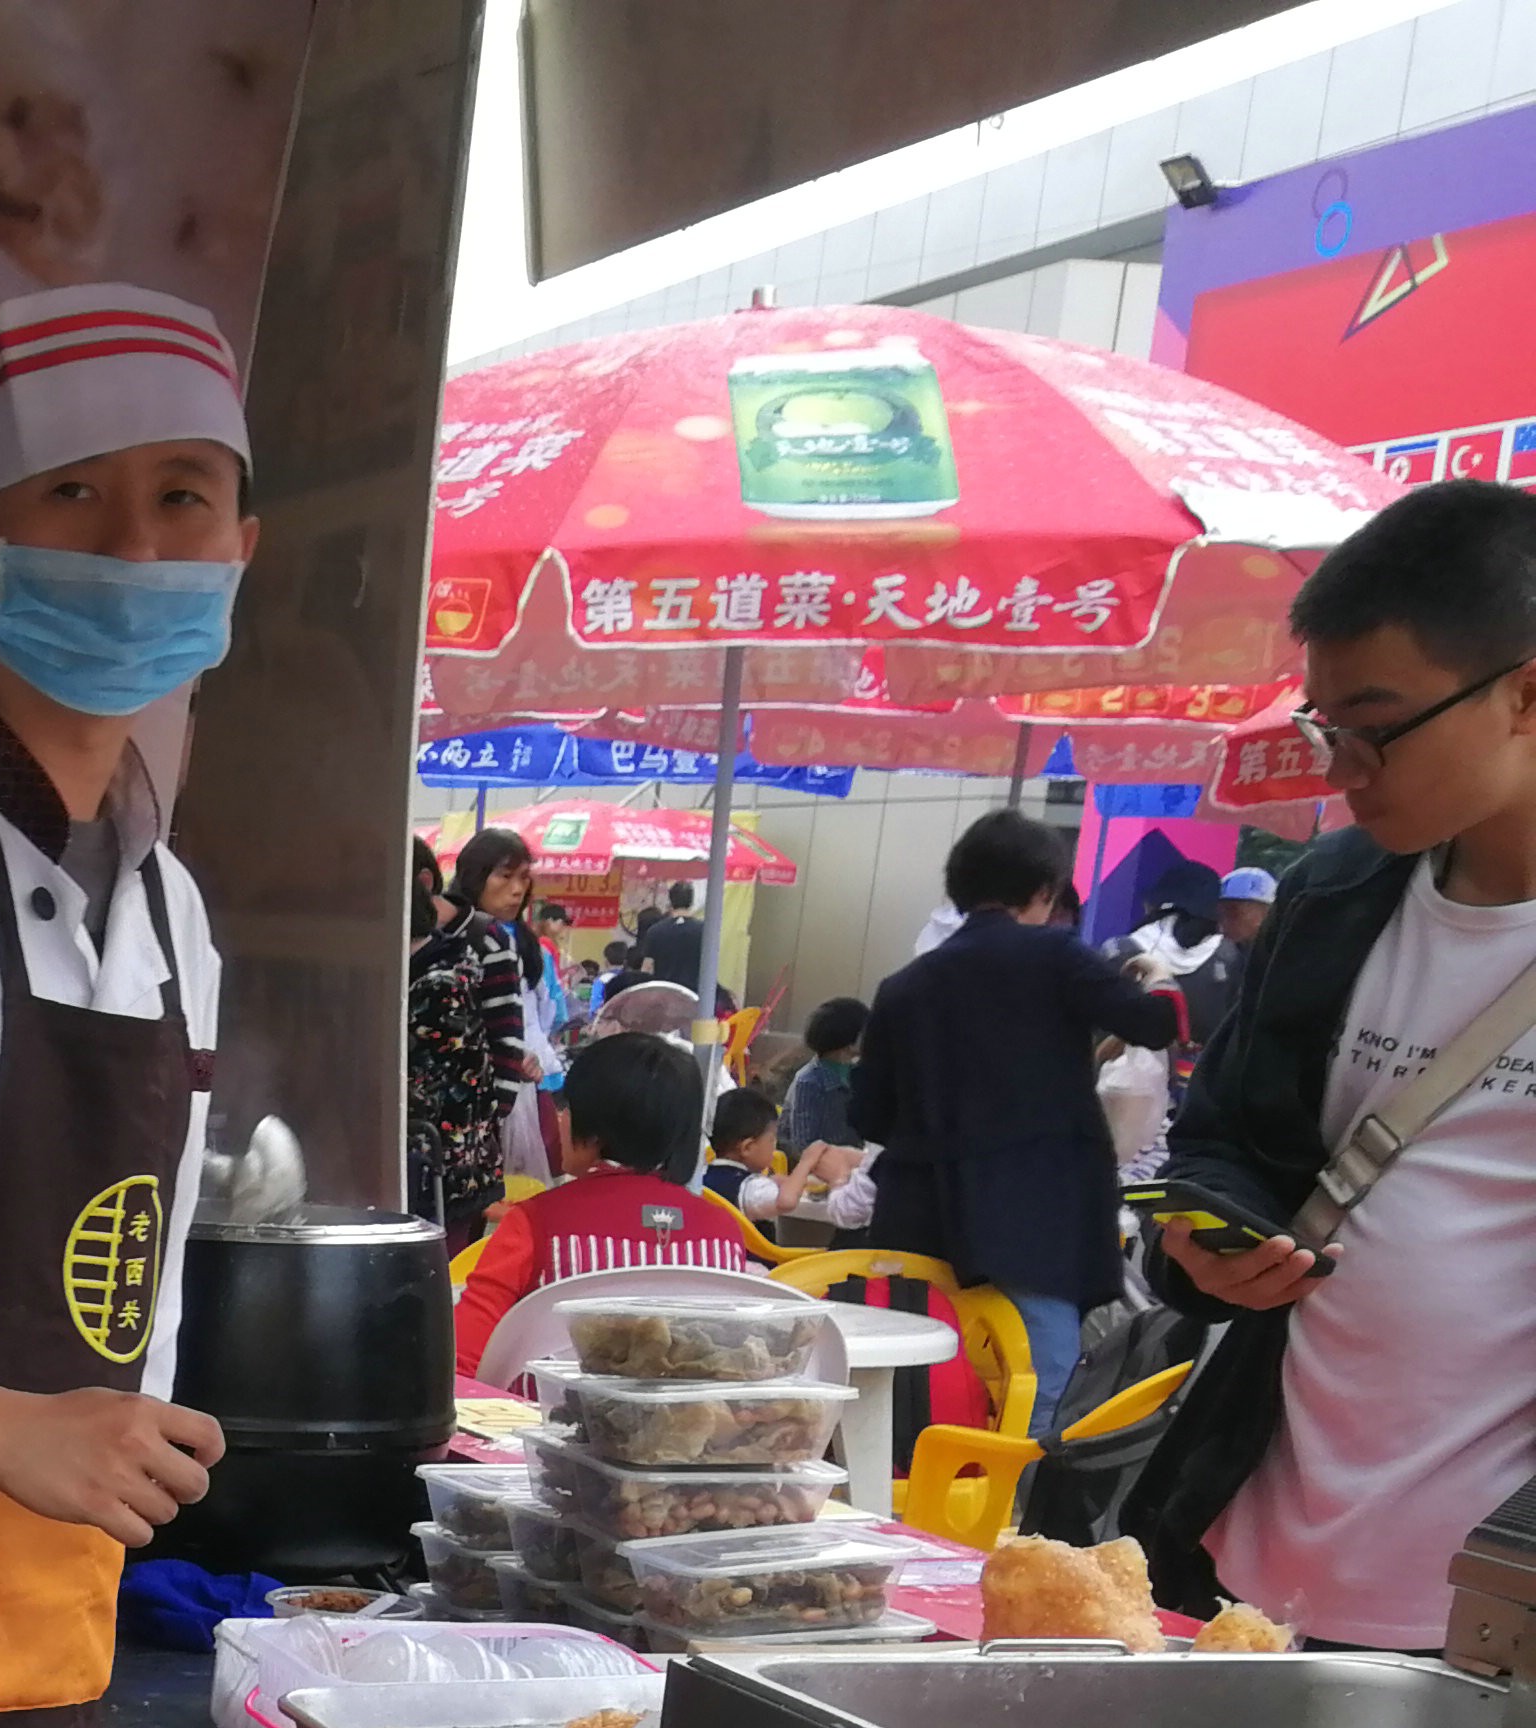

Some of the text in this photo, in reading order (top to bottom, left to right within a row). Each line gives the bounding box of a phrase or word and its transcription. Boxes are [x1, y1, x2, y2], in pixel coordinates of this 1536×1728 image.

[581, 571, 1121, 635] 第五道菜·天地壹号
[117, 1210, 151, 1331] 老西关
